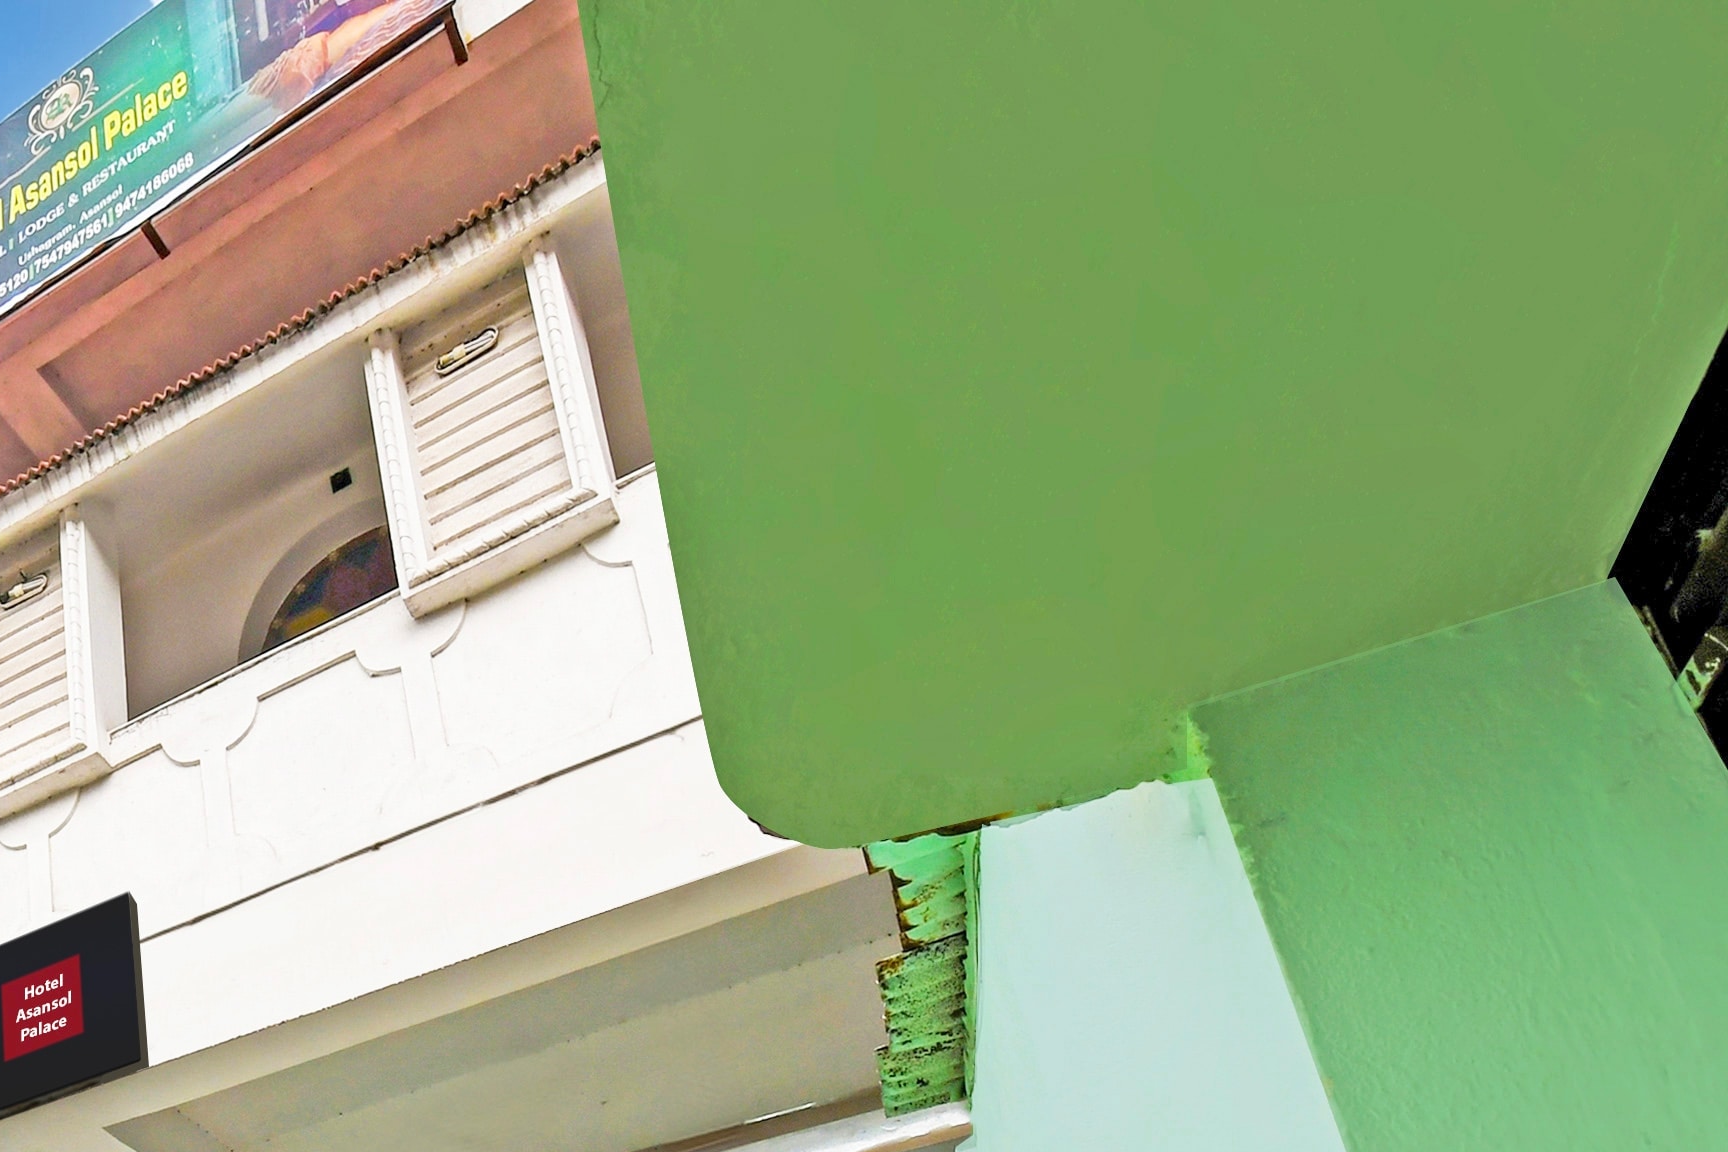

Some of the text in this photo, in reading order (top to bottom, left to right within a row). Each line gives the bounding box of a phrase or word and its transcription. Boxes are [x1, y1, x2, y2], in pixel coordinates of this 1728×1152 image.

[9, 125, 98, 224] Asansol
[104, 71, 188, 150] Palace
[18, 202, 65, 243] LODGE
[68, 193, 79, 207] &
[82, 120, 175, 197] RESTAURANT
[80, 184, 122, 224] Asansol
[24, 973, 63, 1000] Hotel
[15, 990, 72, 1023] Asansol
[20, 1016, 67, 1042] Palace
